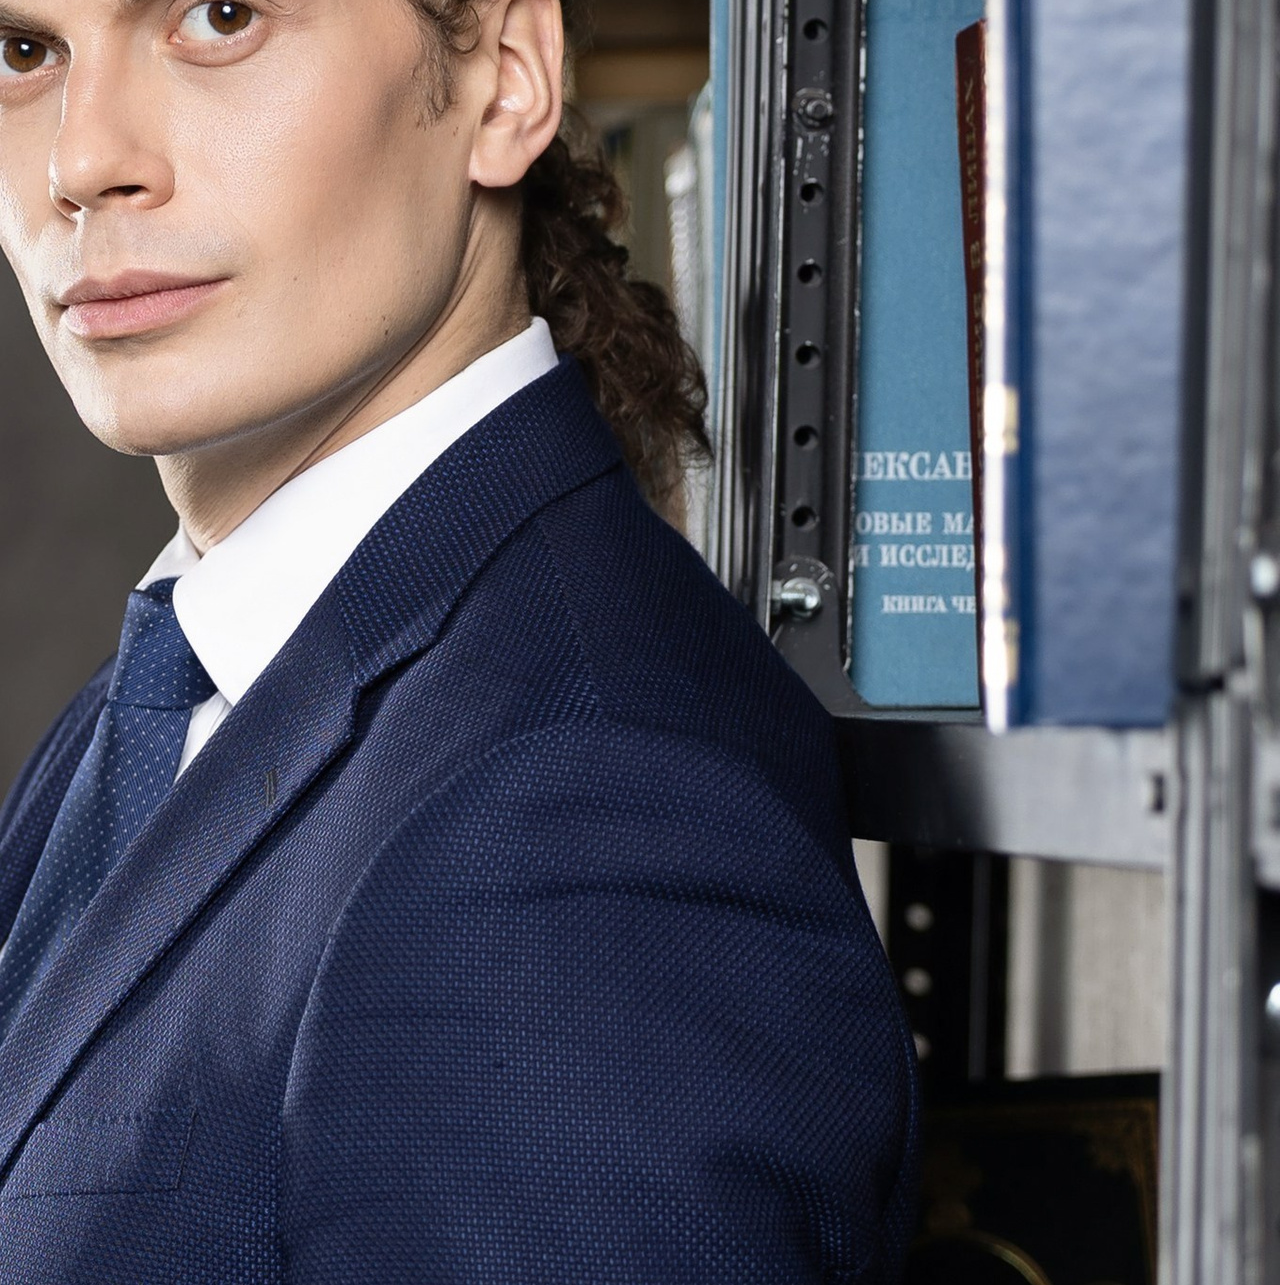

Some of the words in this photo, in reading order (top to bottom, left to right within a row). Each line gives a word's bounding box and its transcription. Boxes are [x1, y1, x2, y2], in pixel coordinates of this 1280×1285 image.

[856, 451, 973, 481] ЕКСАН
[854, 511, 932, 536] ОВЫЕ
[881, 594, 948, 615] КНИГА
